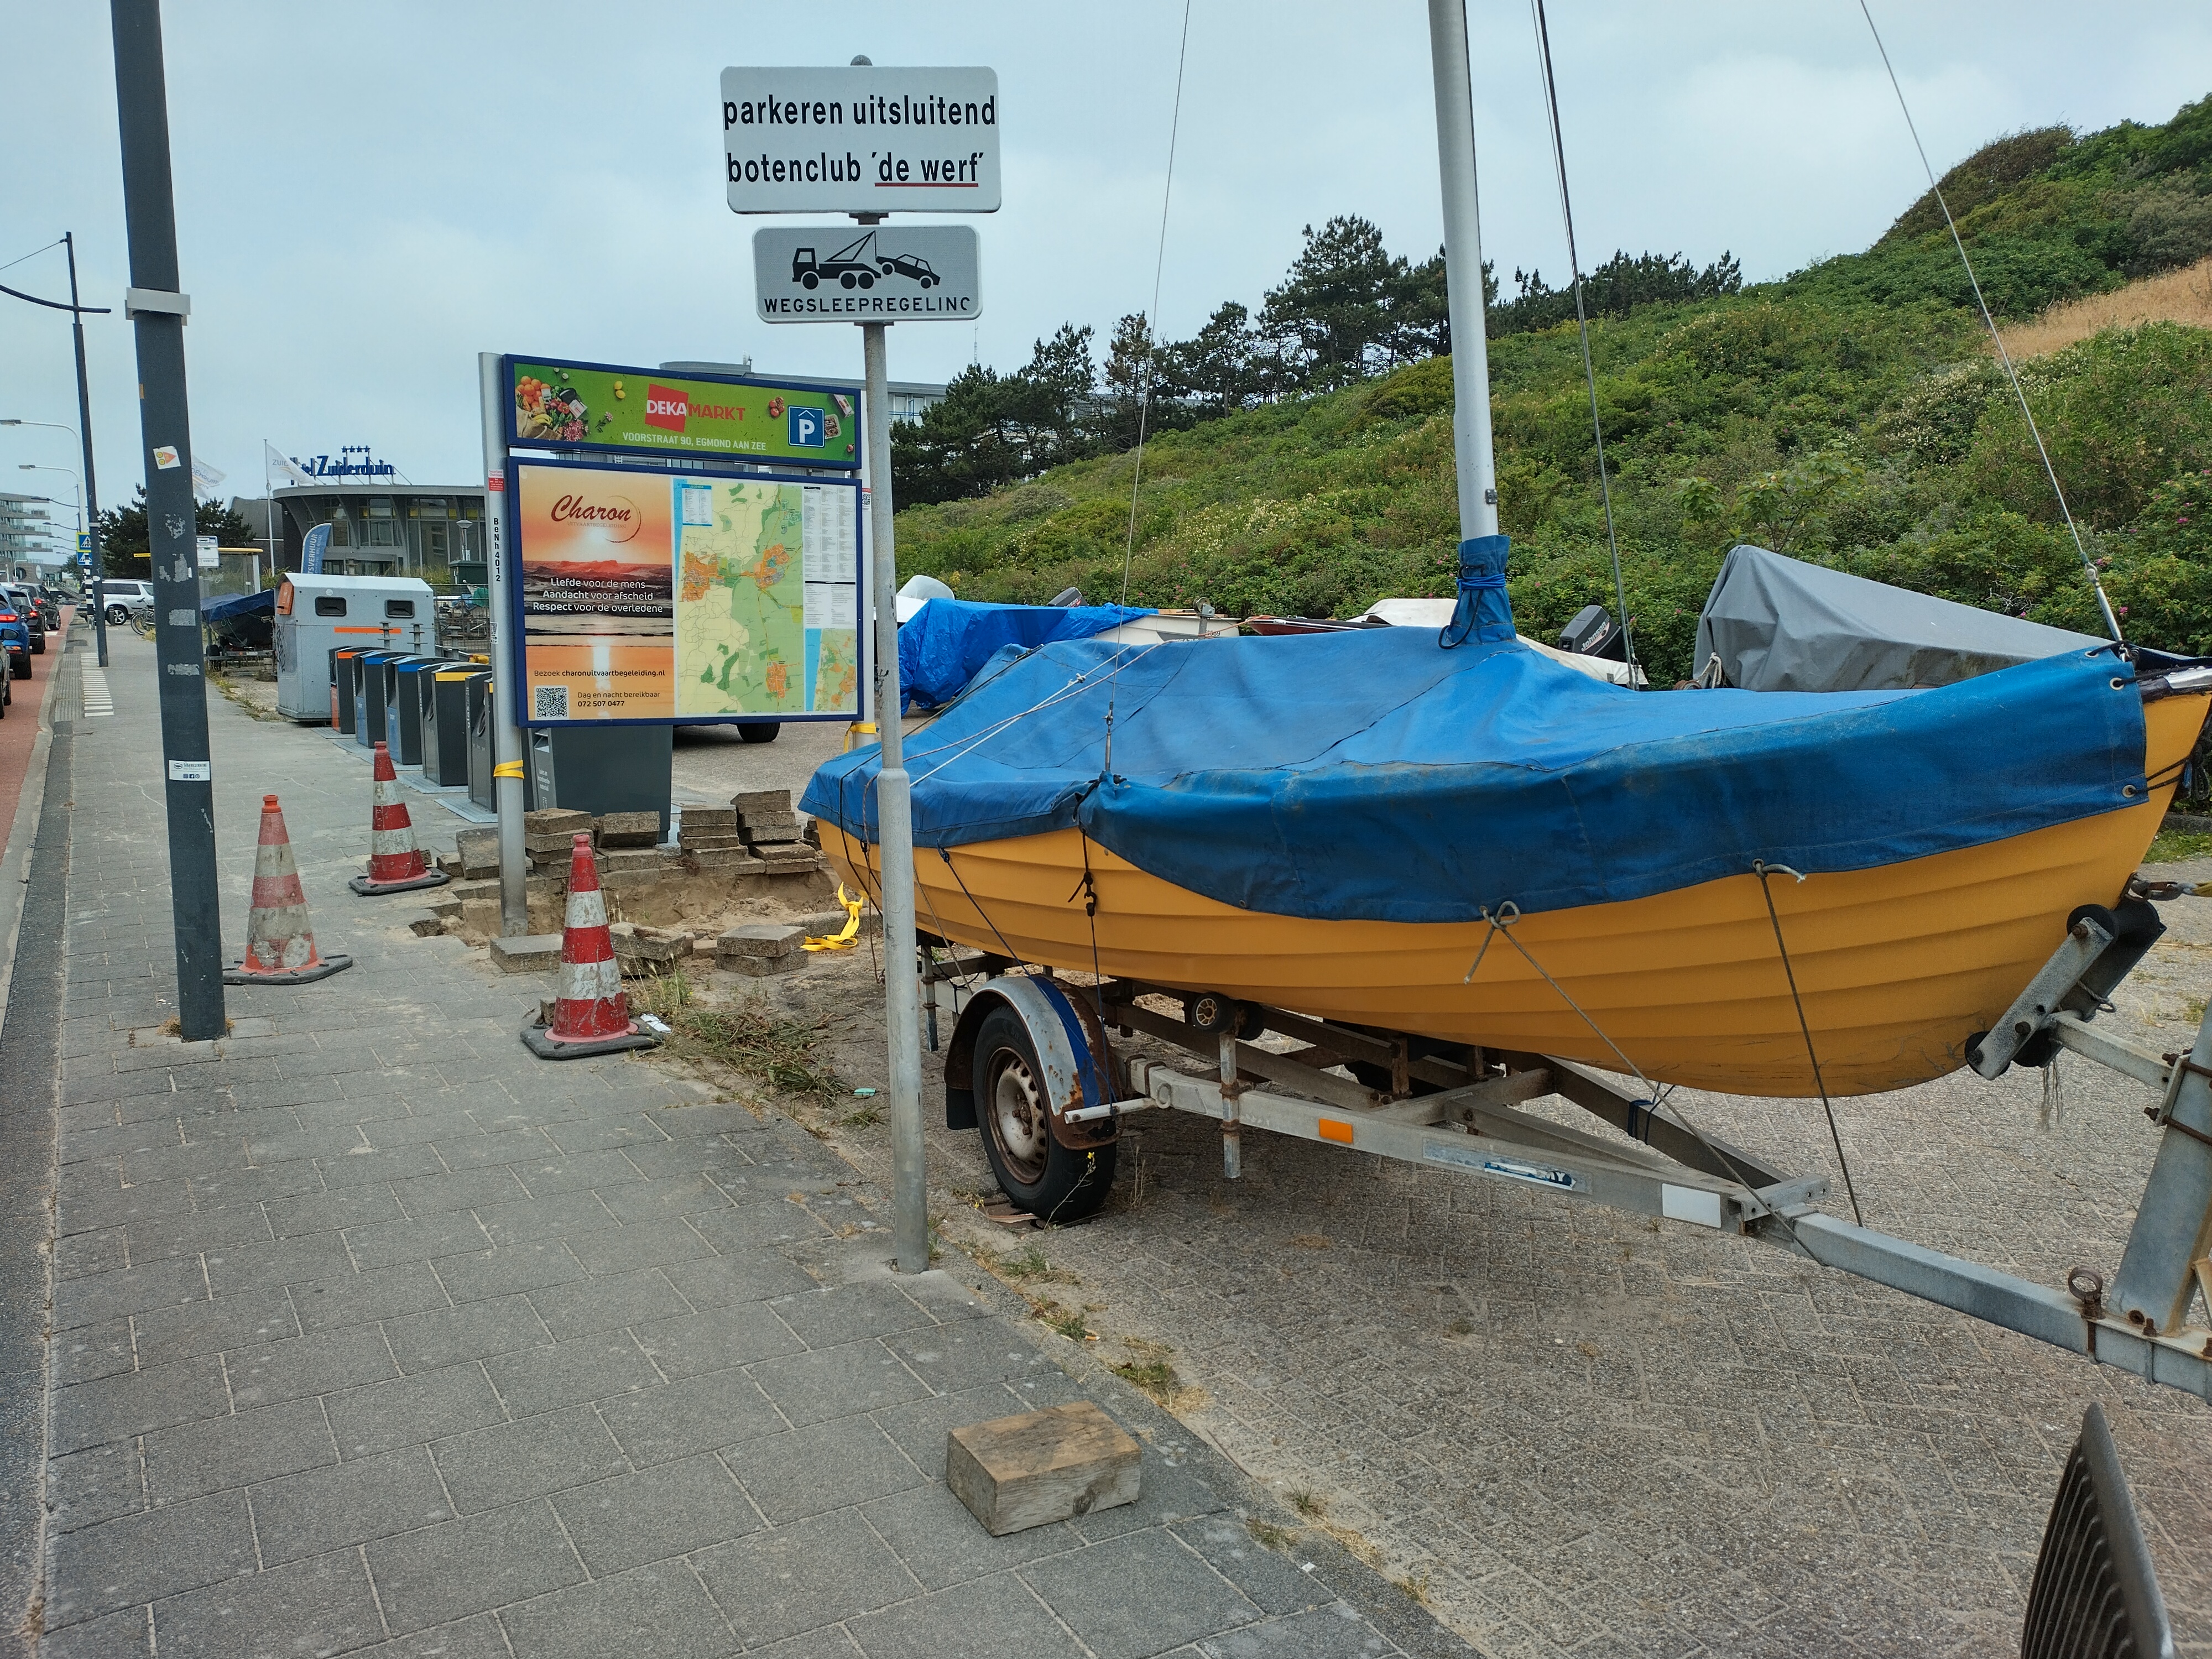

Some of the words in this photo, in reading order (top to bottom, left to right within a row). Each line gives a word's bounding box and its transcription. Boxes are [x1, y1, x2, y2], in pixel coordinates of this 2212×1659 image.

[723, 94, 843, 130] parkeren
[854, 95, 995, 125] uitsluitend
[727, 152, 861, 182] botenclub
[622, 431, 678, 445] VOORSTRAAT
[680, 436, 694, 447] 90,
[696, 437, 731, 448] EGMOND
[732, 440, 749, 449] AAN
[751, 441, 766, 451] ZEE
[799, 419, 815, 444] P
[316, 455, 395, 476] Zuiderduin
[551, 494, 632, 522] Charon
[550, 578, 581, 587] Liefde
[607, 580, 618, 588] de
[542, 590, 589, 599] Aandacht
[614, 592, 654, 601] afscheid
[533, 602, 572, 612] Respect
[611, 604, 663, 613] overledene
[1581, 621, 1606, 651] Johnson
